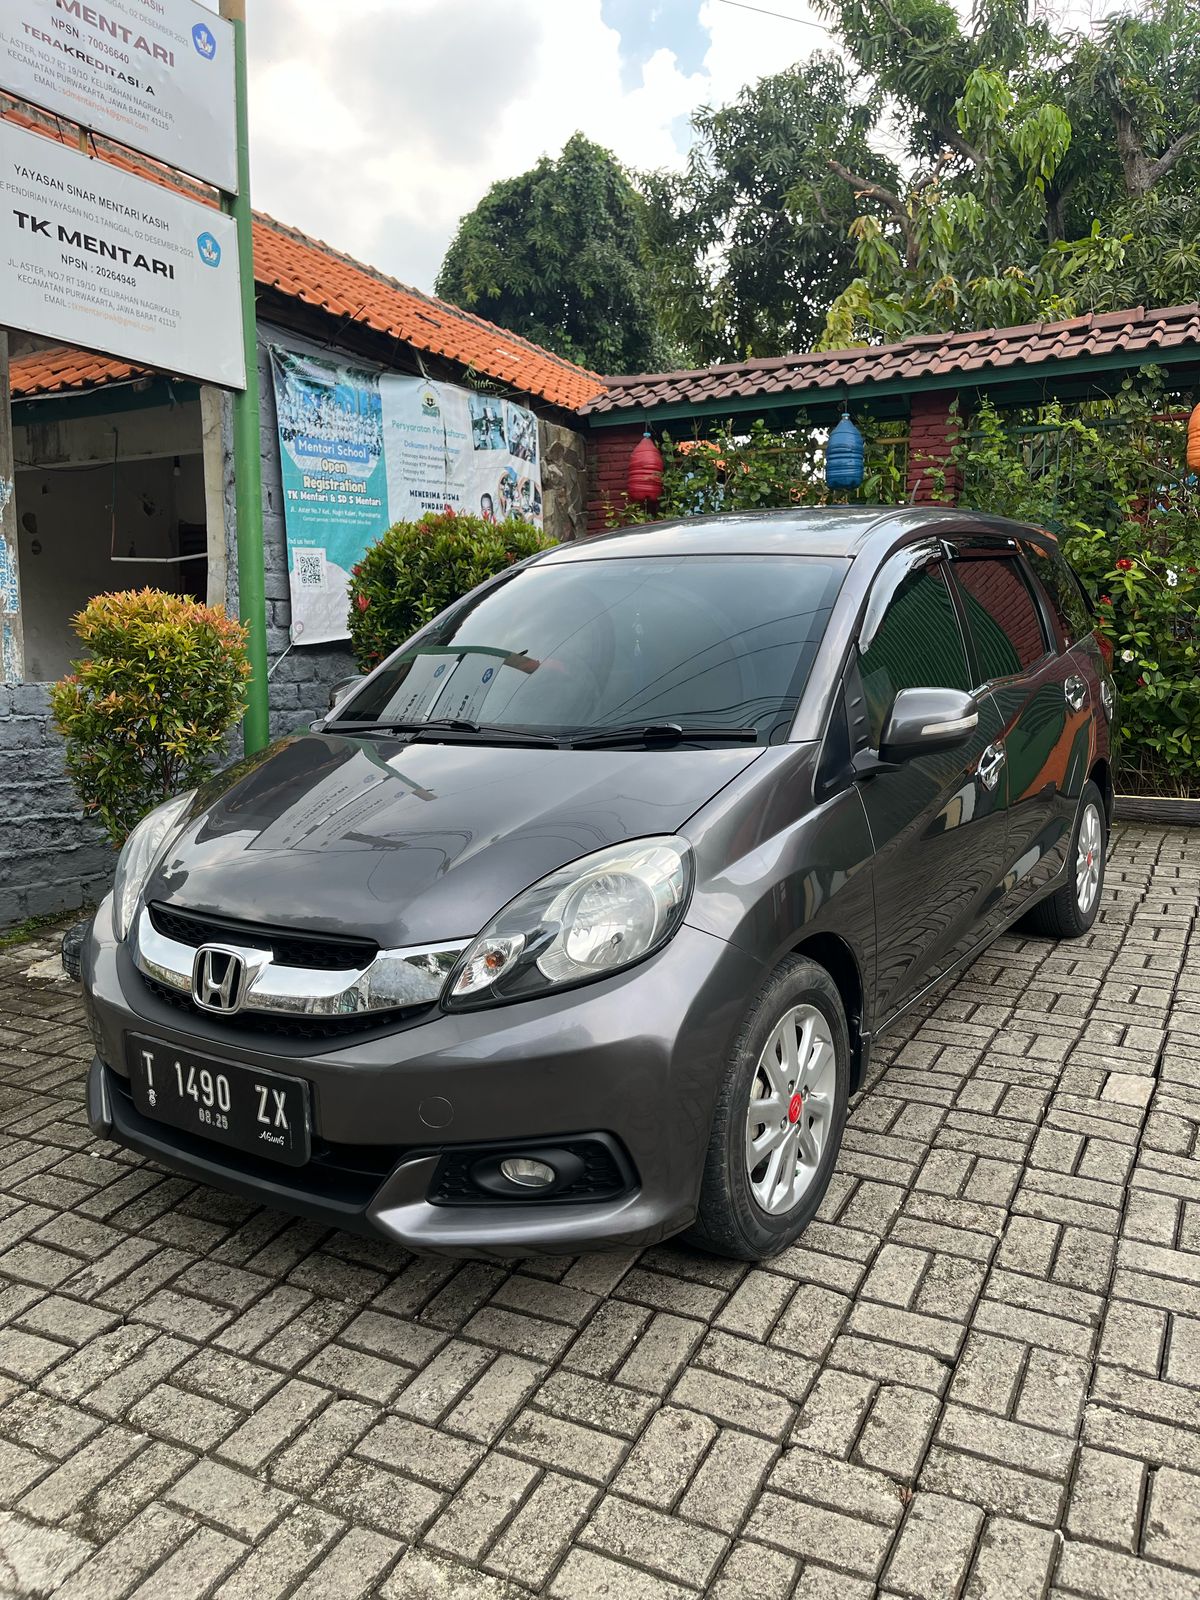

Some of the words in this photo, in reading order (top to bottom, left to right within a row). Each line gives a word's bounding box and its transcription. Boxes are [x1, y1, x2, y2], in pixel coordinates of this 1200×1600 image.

[138, 0, 164, 15] ASIH
[51, 15, 79, 39] NPSN
[88, 35, 130, 64] 70036640
[56, 0, 174, 67] MENTARI
[139, 13, 174, 39] DESEMBER
[22, 22, 139, 88] TERAKREDITASI
[145, 85, 155, 97] A
[7, 48, 55, 78] KECAMATAN
[56, 72, 107, 104] PURWAKARTA,
[108, 97, 128, 111] JAWA
[128, 106, 150, 121] BARAT
[151, 117, 170, 131] 41115
[10, 37, 37, 56] ASTER,
[38, 50, 56, 65] NO.7
[57, 58, 67, 71] RT
[68, 65, 89, 81] 19/10
[91, 76, 132, 102] KELURAHAN
[133, 97, 175, 123] NAGRIKALER,
[33, 74, 57, 91] EMAIL
[14, 163, 64, 191] YAYASAN
[66, 184, 96, 204] SINAR
[99, 196, 140, 220] MENTARI
[142, 213, 169, 231] KASIH
[6, 183, 47, 204] PENDIRIAN
[48, 199, 82, 217] YAYASAN
[83, 211, 100, 224] NO.1
[100, 217, 134, 237] TANGGAL,
[134, 230, 144, 239] 02
[145, 233, 179, 252] DESEMBER
[13, 209, 52, 239] TK
[58, 225, 174, 279] MENTARI
[61, 254, 88, 271] NPSN
[96, 266, 137, 287] 20264948
[7, 258, 19, 268] JL.
[20, 261, 46, 278] ASTER,
[47, 270, 65, 281] NO.7
[66, 275, 75, 285] RT
[76, 279, 96, 292] 19/10
[99, 286, 139, 305] KELURAHAN
[140, 299, 182, 320] NAGRIKALER,
[17, 273, 64, 294] KECAMATAN
[65, 288, 115, 311] PURWAKARTA,
[116, 305, 135, 316] JAWA
[136, 309, 157, 323] BARAT
[158, 317, 177, 328] 41115
[44, 293, 67, 307] EMAIL
[392, 420, 431, 434] Persyaratan
[298, 440, 335, 454] Mentari
[337, 445, 367, 459] School
[321, 458, 347, 474] Open
[287, 490, 298, 500] TK
[300, 491, 328, 502] Mentari
[337, 495, 347, 504] SD
[349, 496, 354, 504] S
[355, 496, 382, 506] Mentari
[303, 475, 367, 493] Registration!
[409, 490, 440, 499] MENERIMA
[141, 1049, 154, 1087] T
[174, 1061, 231, 1112] 1490
[254, 1084, 289, 1130] ZX
[198, 1107, 229, 1130] 08.25
